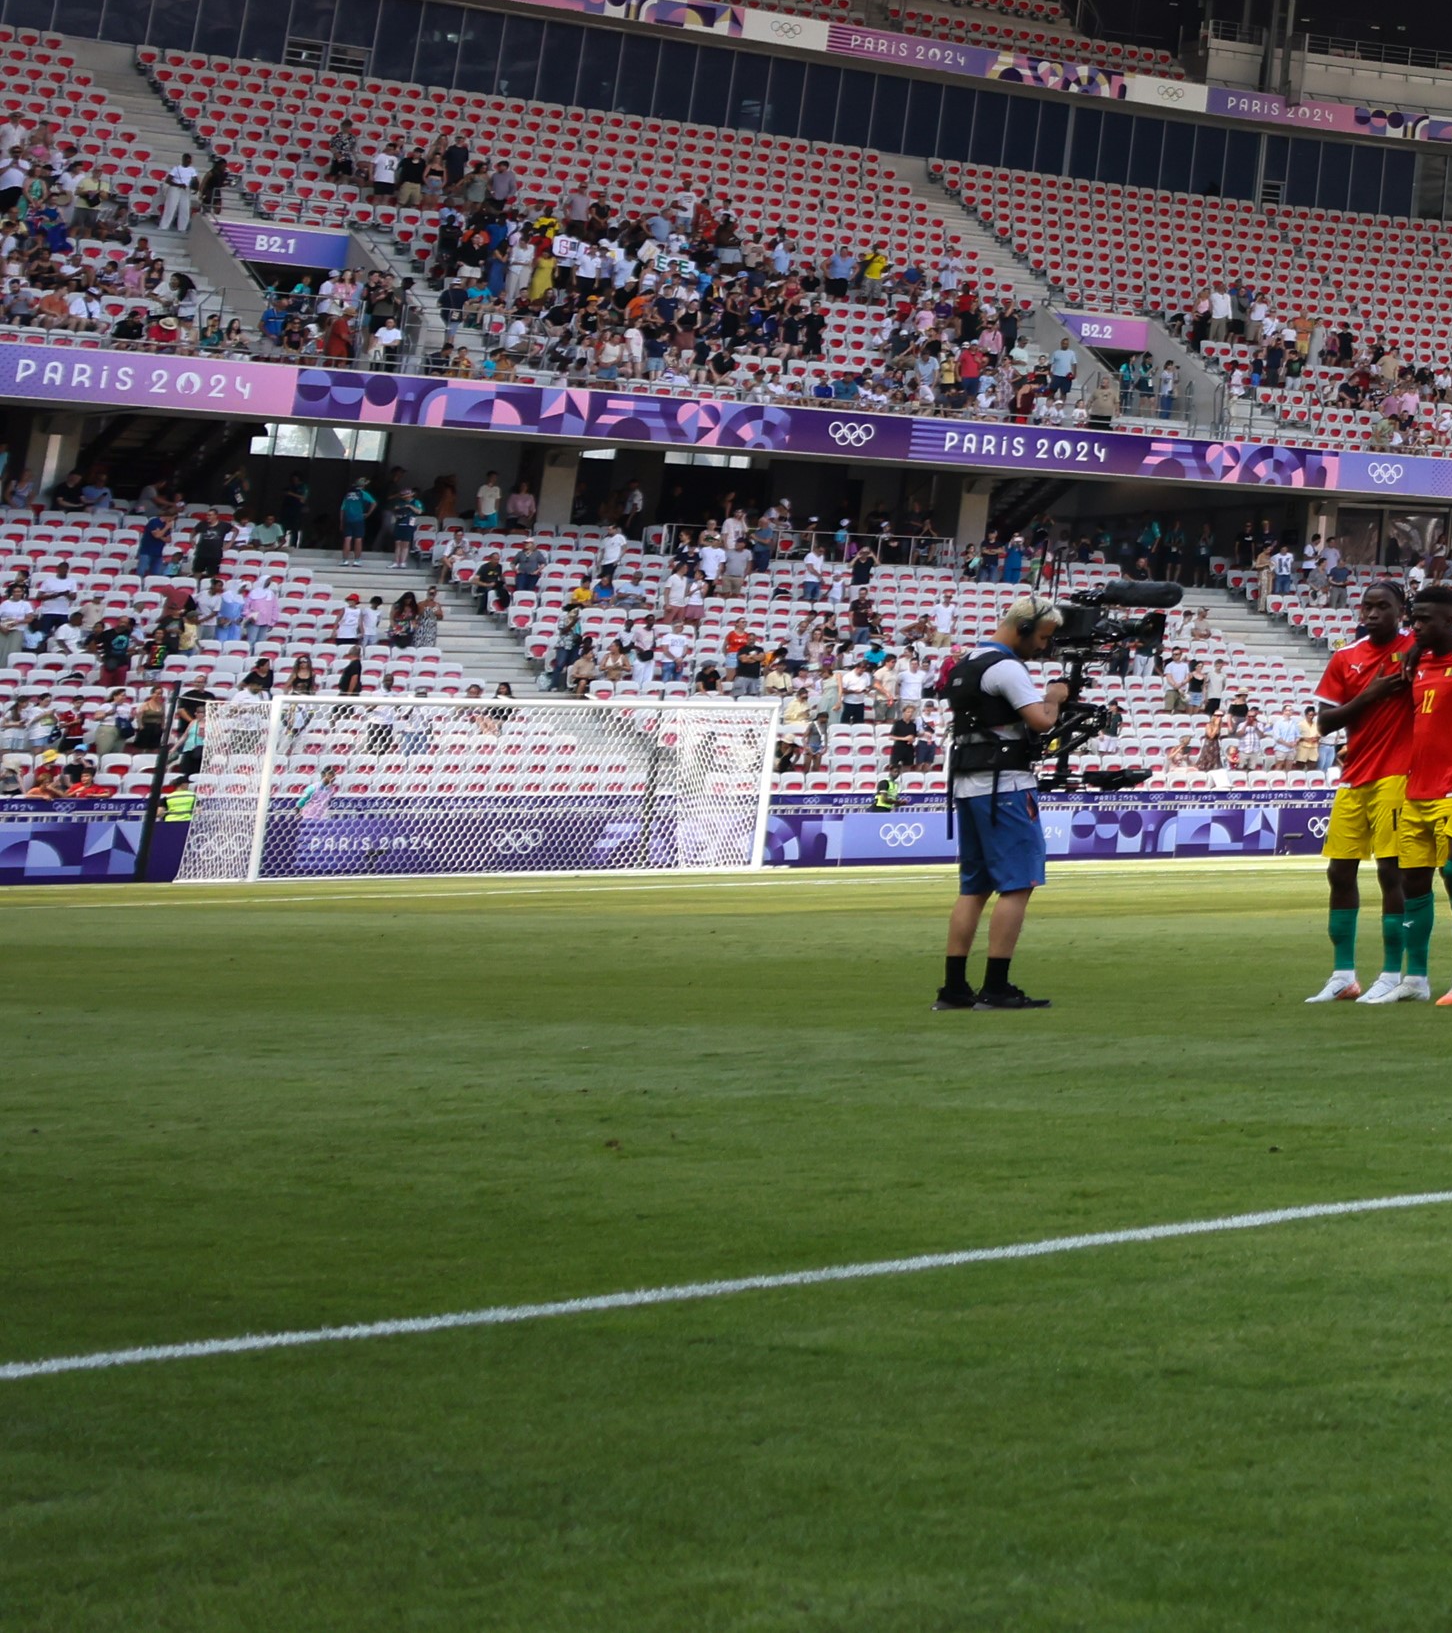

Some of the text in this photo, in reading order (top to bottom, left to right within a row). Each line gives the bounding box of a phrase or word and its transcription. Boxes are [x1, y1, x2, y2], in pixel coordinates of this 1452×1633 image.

[915, 46, 966, 66] 2024
[1286, 106, 1334, 123] 2024
[255, 235, 295, 253] B2.1
[1081, 323, 1112, 339] B2.2
[149, 370, 252, 399] 2024
[1036, 439, 1106, 462] 2024
[1422, 689, 1434, 714] 12
[1391, 808, 1403, 831] 1
[1044, 826, 1062, 838] 24
